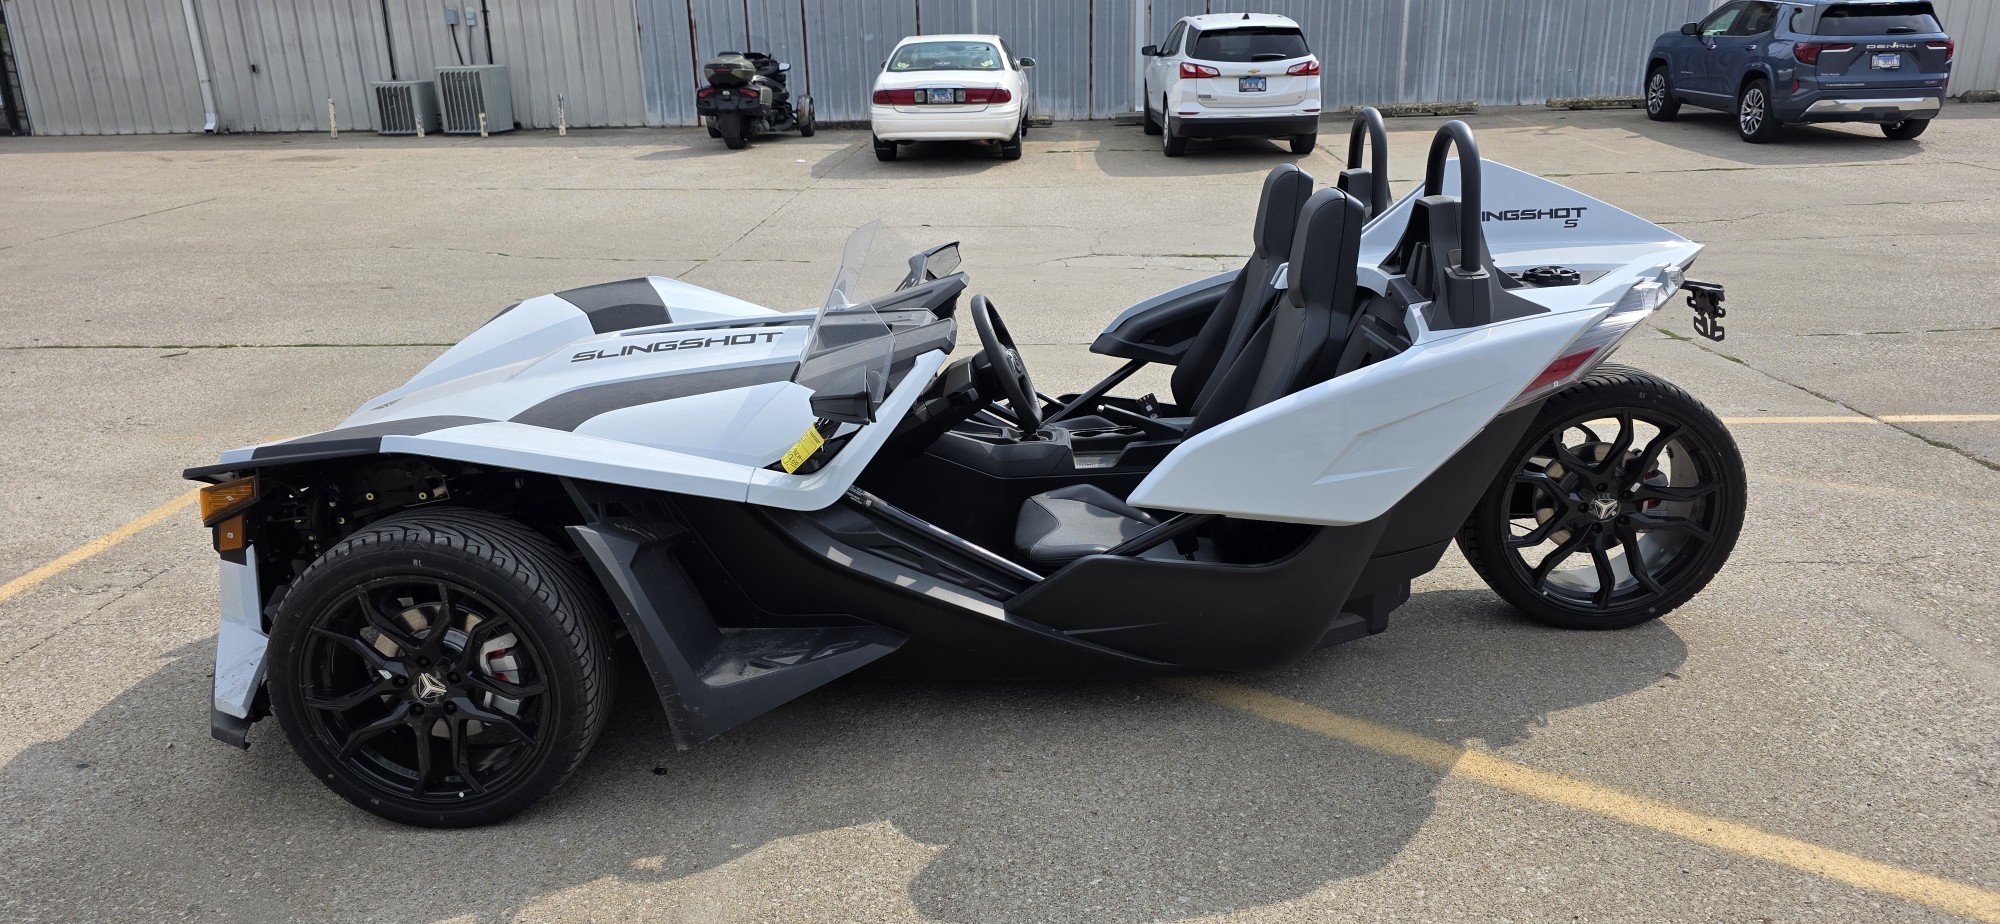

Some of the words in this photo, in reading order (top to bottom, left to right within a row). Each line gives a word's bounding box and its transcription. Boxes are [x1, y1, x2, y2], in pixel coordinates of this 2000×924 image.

[1482, 207, 1588, 222] INGSHOT
[1563, 219, 1578, 228] S
[570, 331, 784, 363] SLINGSHOT
